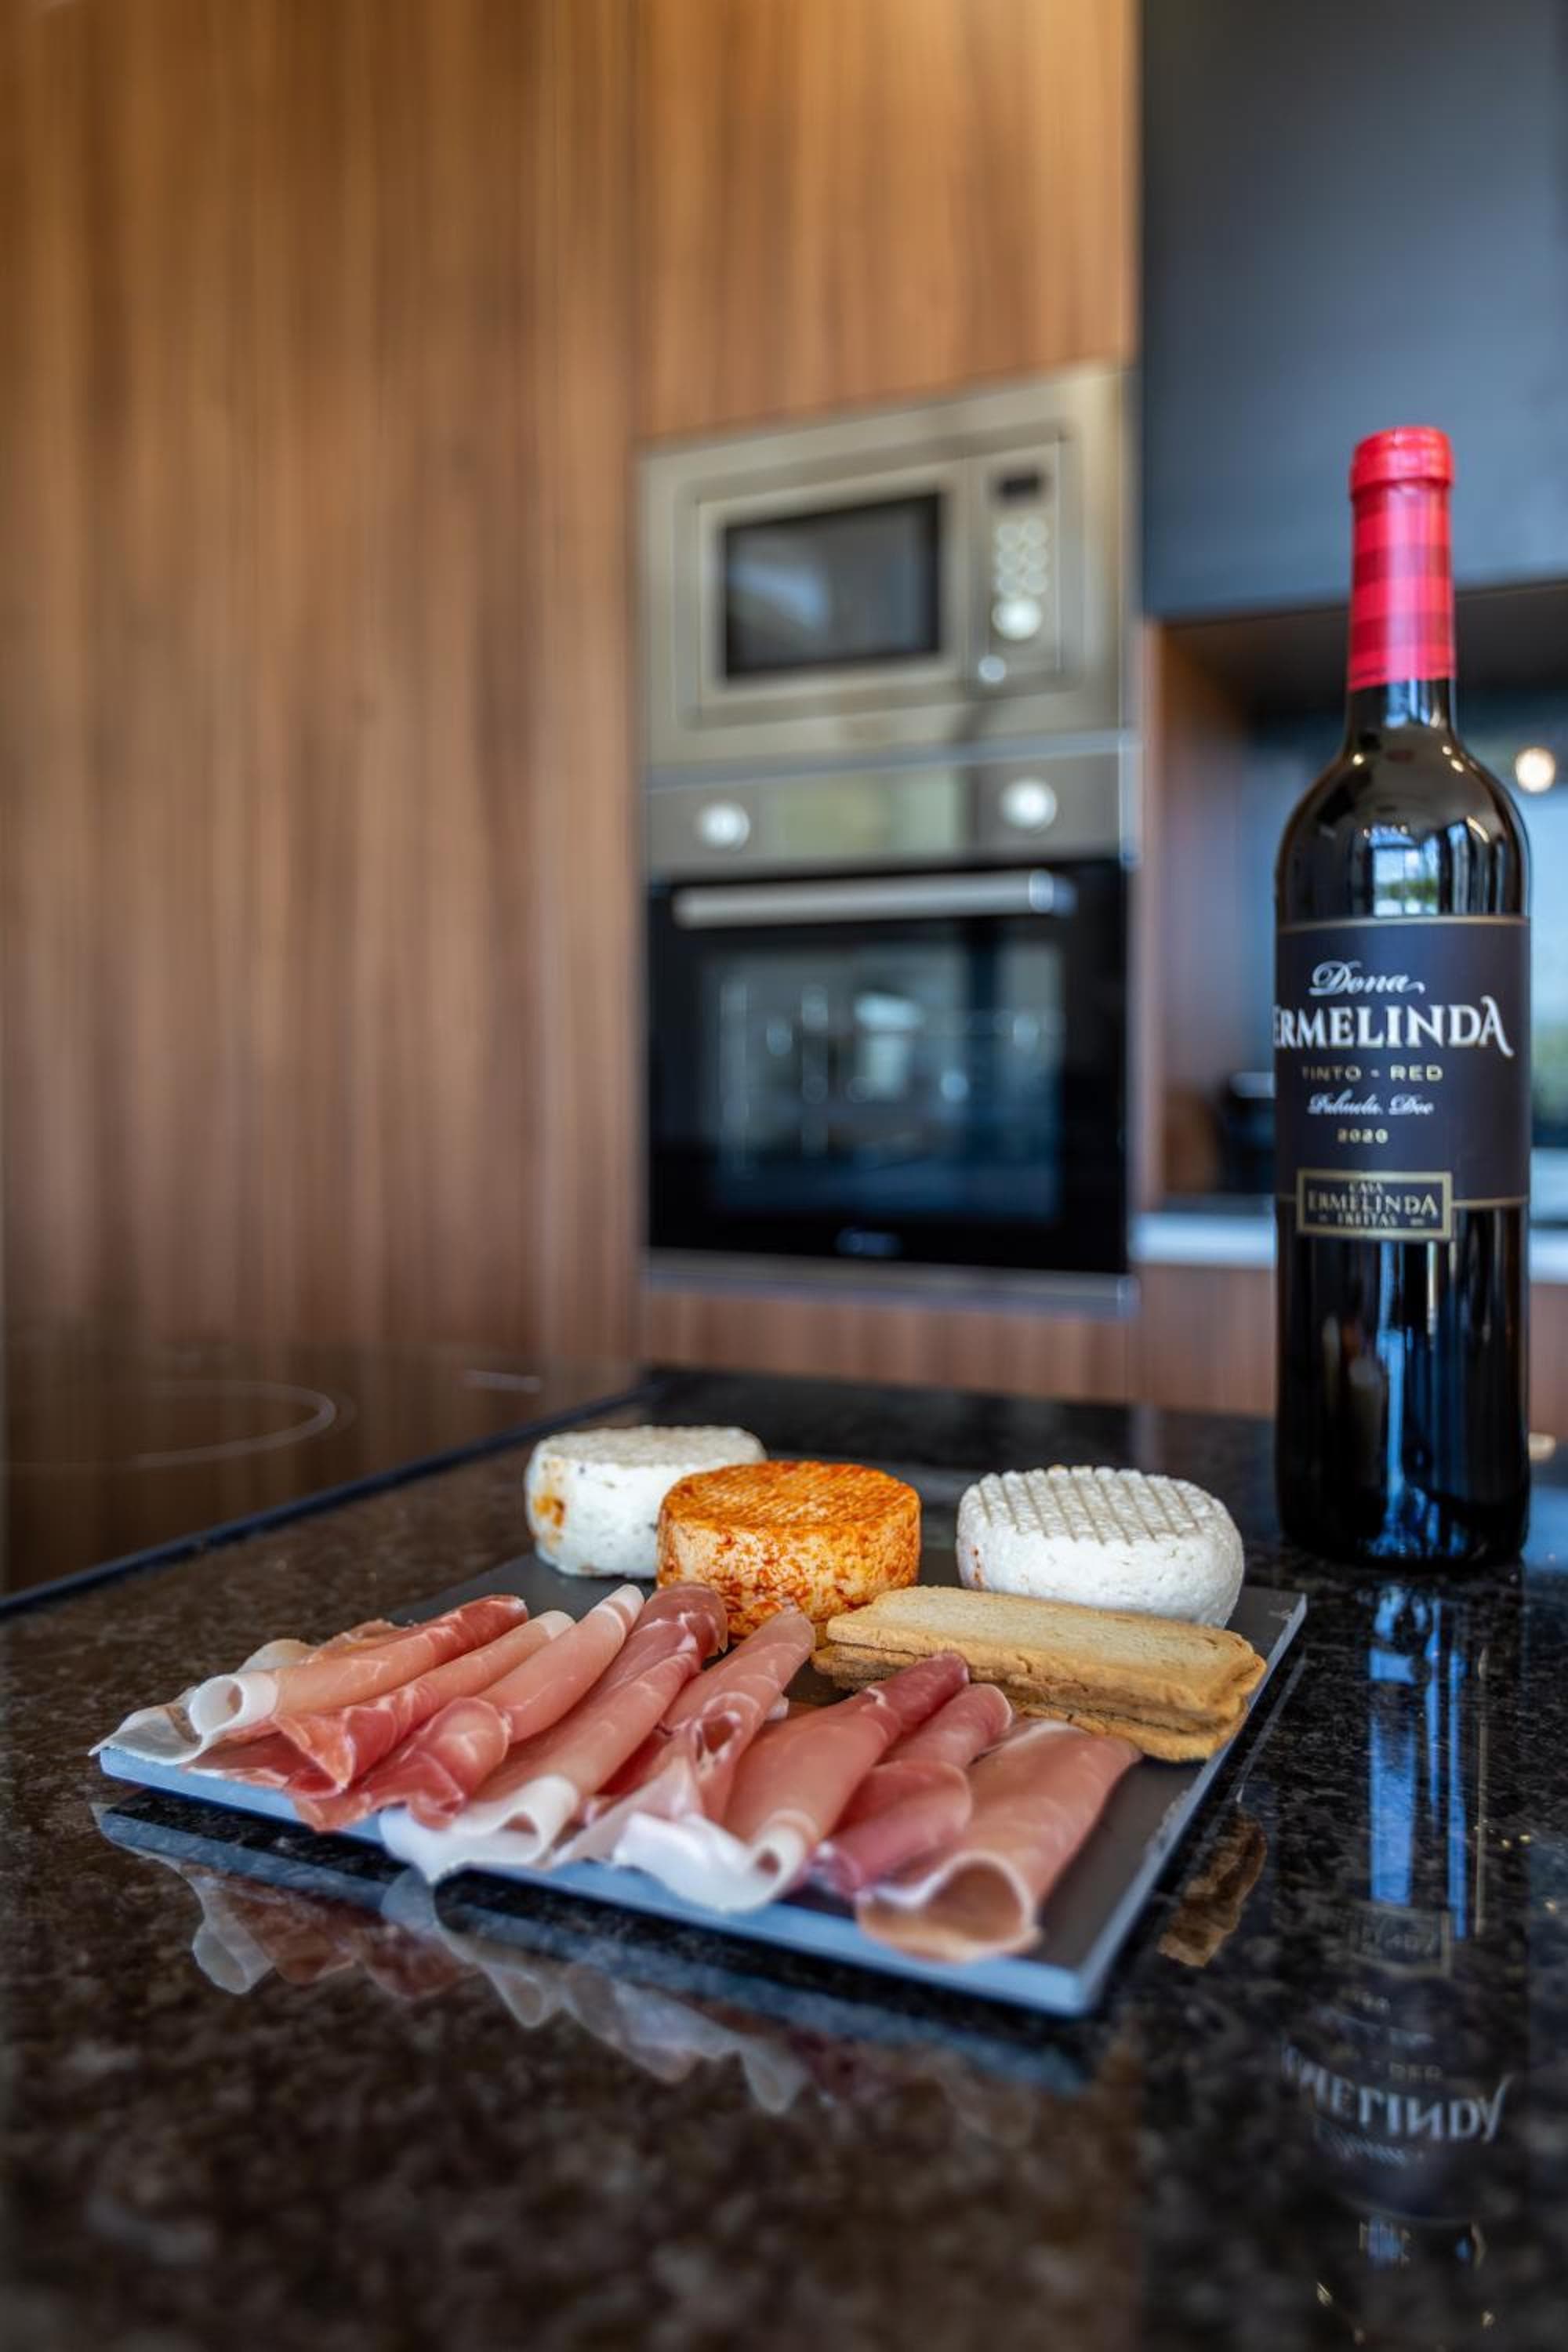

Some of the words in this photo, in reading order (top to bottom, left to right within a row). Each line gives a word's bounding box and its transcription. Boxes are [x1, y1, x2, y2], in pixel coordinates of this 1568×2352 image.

[1308, 960, 1425, 996] Dona
[1272, 996, 1514, 1058] ERMELINDA
[1302, 1065, 1363, 1082] TINTO
[1390, 1064, 1443, 1082] RED
[1307, 1189, 1439, 1220] ERMELINDA
